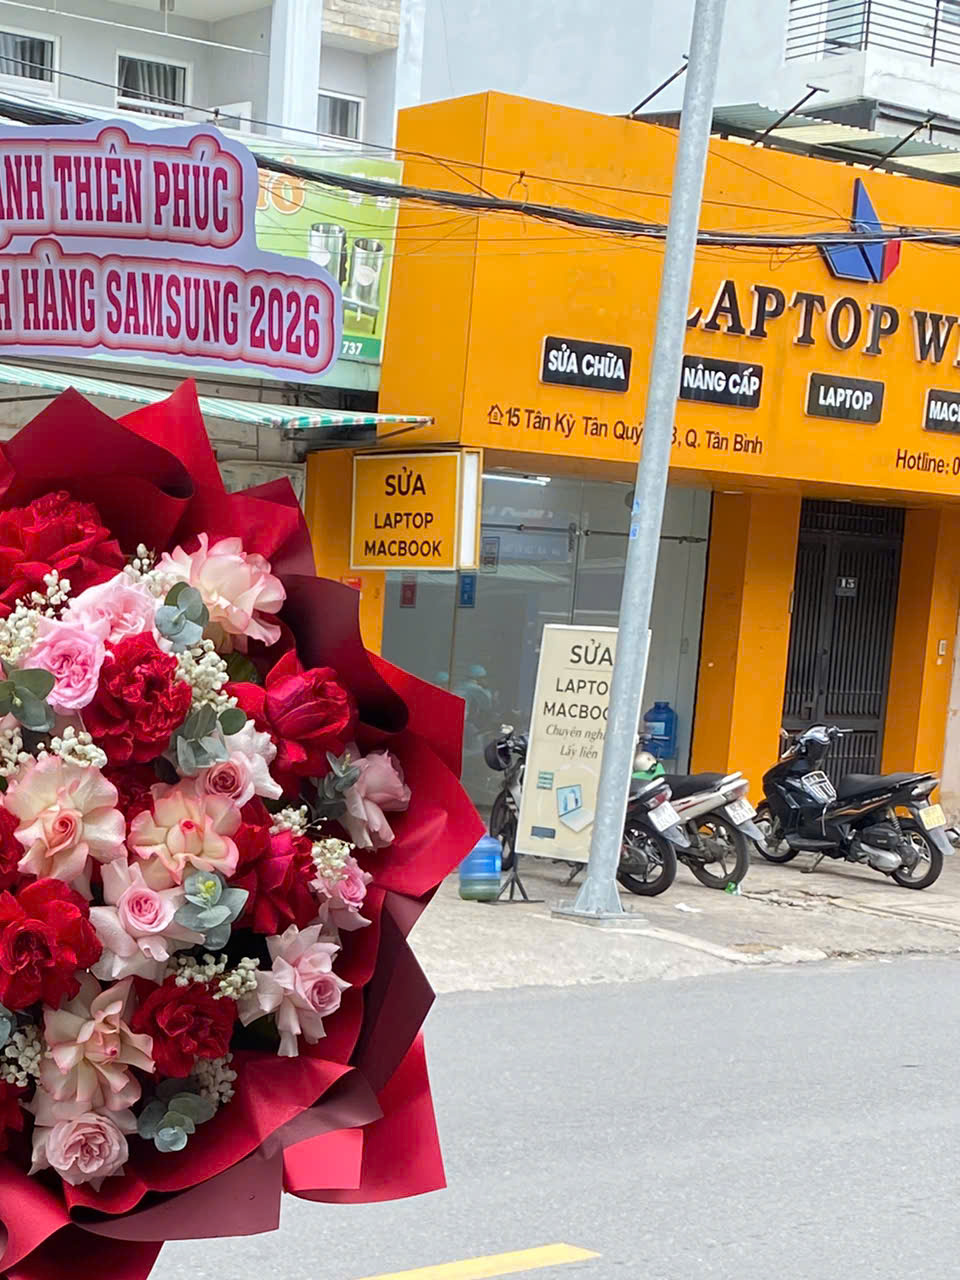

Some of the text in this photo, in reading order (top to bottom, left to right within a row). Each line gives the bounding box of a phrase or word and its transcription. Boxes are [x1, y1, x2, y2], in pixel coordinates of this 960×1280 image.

[53, 143, 142, 224] THIÊN
[153, 150, 228, 233] PHÚC
[20, 253, 96, 332] HÀNG
[106, 269, 238, 345] SAMSUNG
[250, 285, 320, 358] 2026
[342, 341, 363, 355] 737
[911, 310, 960, 366] W
[548, 343, 625, 380] SỬA CHỮA
[683, 364, 760, 396] NÂNG CẤP
[818, 385, 873, 411] LAPTOP
[929, 400, 960, 422] MAC
[505, 407, 521, 426] 15
[524, 409, 551, 431] Tân
[554, 413, 576, 438] Kỳ
[582, 416, 608, 437] Tân
[613, 421, 643, 445] Quý
[685, 428, 701, 448] Q.
[705, 430, 729, 450] Tân
[733, 433, 763, 454] Bình
[896, 448, 950, 474] Hotline:
[385, 466, 426, 496] SỬA
[374, 512, 434, 529] LAPTOP
[364, 540, 442, 557] MACBOOK
[570, 638, 613, 666] SỬA
[556, 677, 609, 696] LAPTO
